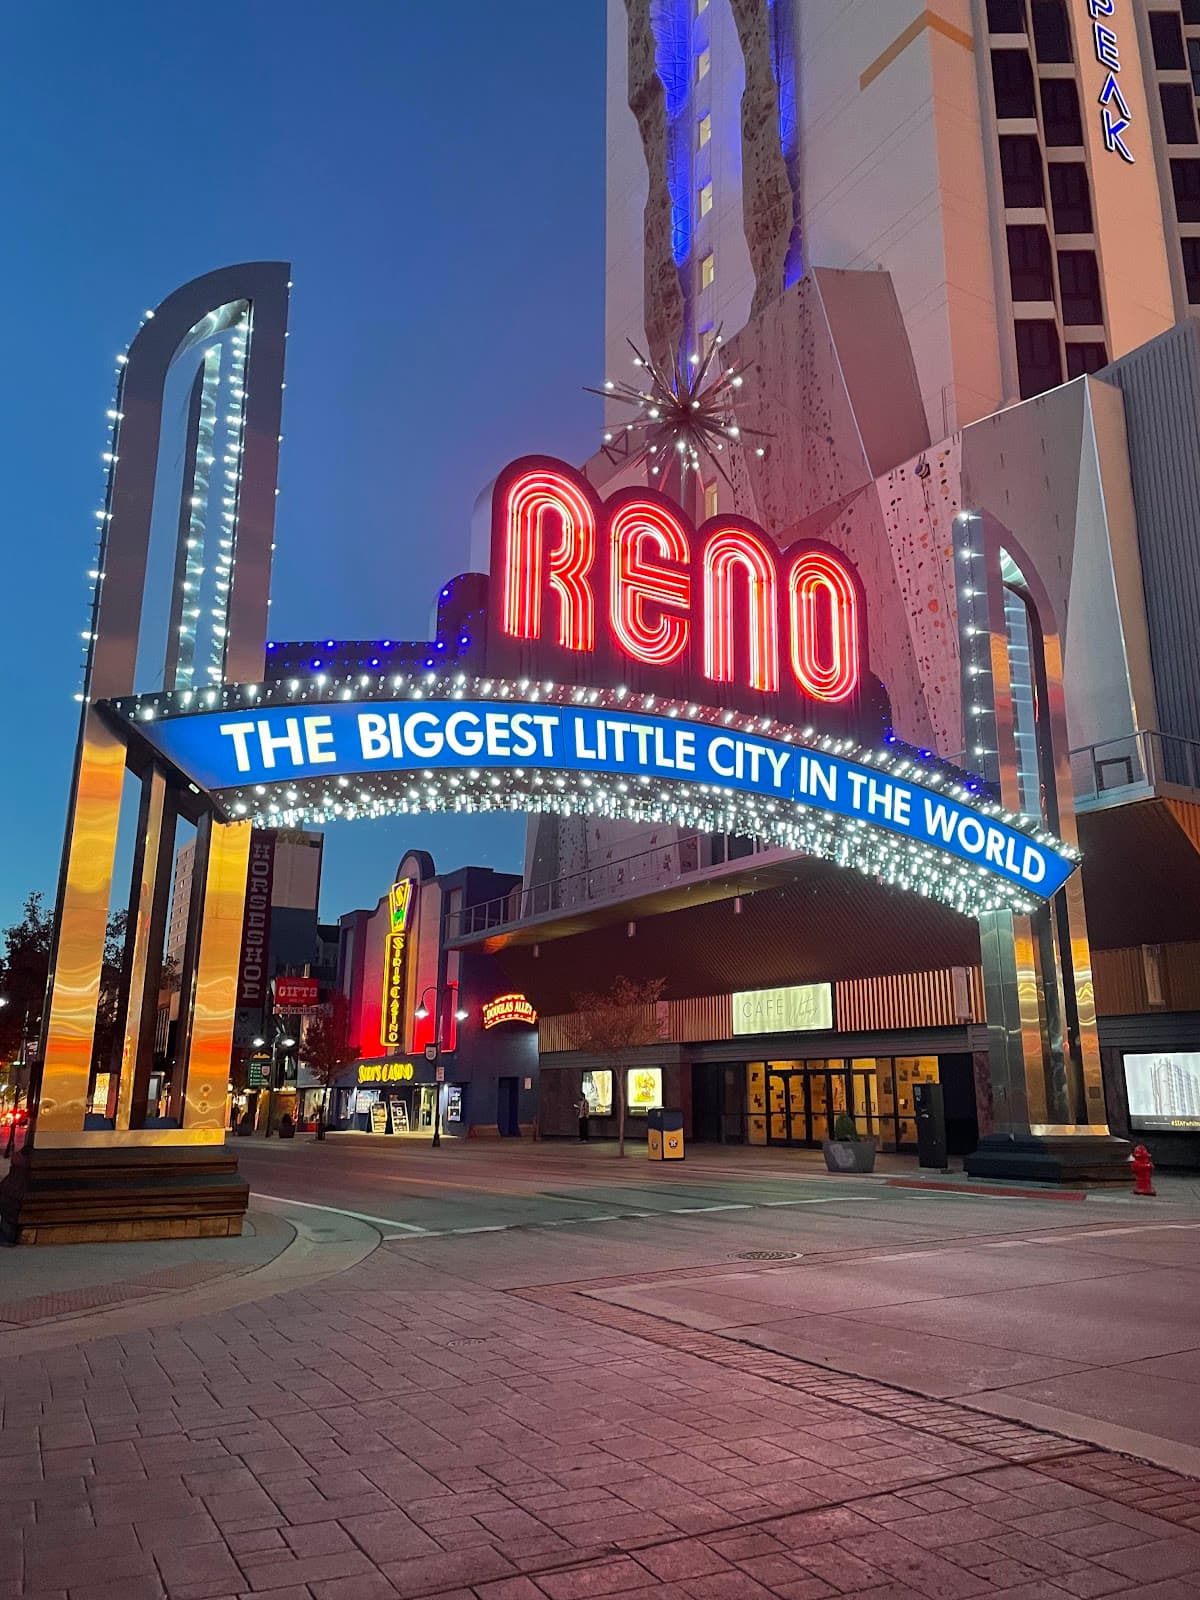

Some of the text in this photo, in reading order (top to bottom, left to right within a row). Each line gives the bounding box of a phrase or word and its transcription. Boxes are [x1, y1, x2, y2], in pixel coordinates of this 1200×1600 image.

[219, 711, 1046, 884] THE BIGGEST LITTLE CITY IN THE WORLD
[242, 843, 271, 999] HORSESHOE
[279, 986, 318, 998] GIFTS
[486, 1000, 533, 1021] DOUGLAS ALLEY
[388, 986, 401, 1042] CASINO
[382, 1063, 414, 1082] CASINO
